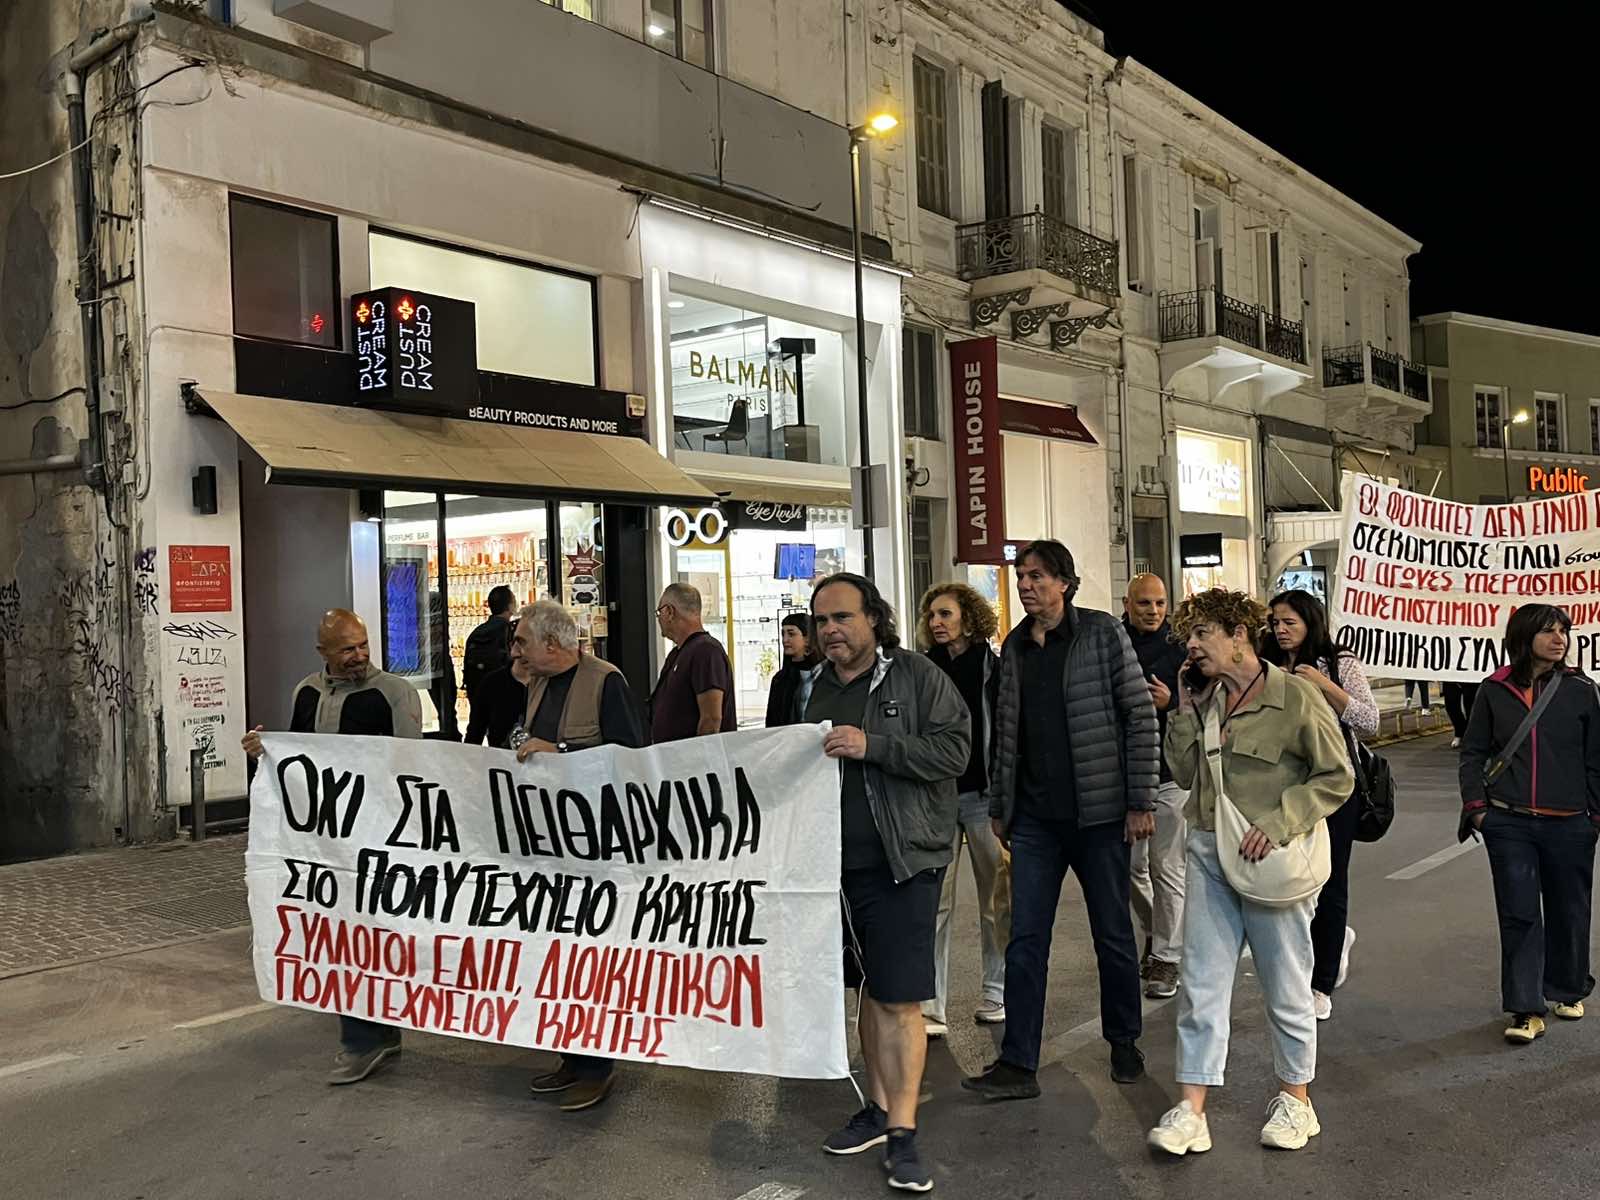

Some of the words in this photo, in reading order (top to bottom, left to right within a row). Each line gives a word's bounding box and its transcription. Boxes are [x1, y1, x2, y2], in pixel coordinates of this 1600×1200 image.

[358, 326, 373, 391] DUST
[371, 301, 388, 389] CREAM
[399, 323, 416, 388] DUST
[416, 304, 433, 391] CREAM
[690, 351, 797, 395] BALMAIN
[469, 407, 512, 423] BEAUTY
[514, 411, 568, 429] PRODUCTS
[569, 418, 590, 431] AND
[592, 420, 618, 434] MORE
[727, 393, 767, 412] PARIS
[964, 361, 984, 456] HOUSE
[969, 466, 988, 546] LAPIN
[1360, 483, 1378, 517] ΟΙ
[1386, 491, 1474, 537] ΦΟΙΤΗΤΕΣ
[1482, 506, 1526, 539] ΔΕΝ
[1529, 466, 1590, 493] Public
[1346, 555, 1367, 583] ΟΙ
[277, 753, 365, 839] ΟΧΙ
[385, 774, 461, 853] ΣΤΑ
[489, 767, 761, 865] ΠΕΙΘΑΡΧΙΚΑ
[282, 858, 338, 909] ΣΤΟ
[355, 847, 617, 937] ΠΟΛΥΤΕΧΝΕΙΟ
[631, 873, 767, 949] ΚΡΗΤΗΣ
[275, 905, 416, 978] ΣΥΛΛΟΓΟΙ
[433, 934, 522, 997] ΕΔΙΠ,
[276, 958, 520, 1042] ΠΟΛΥΤΕΧΝΕΙΟΥ
[535, 1002, 677, 1058] ΚΡΗΤΗΣ
